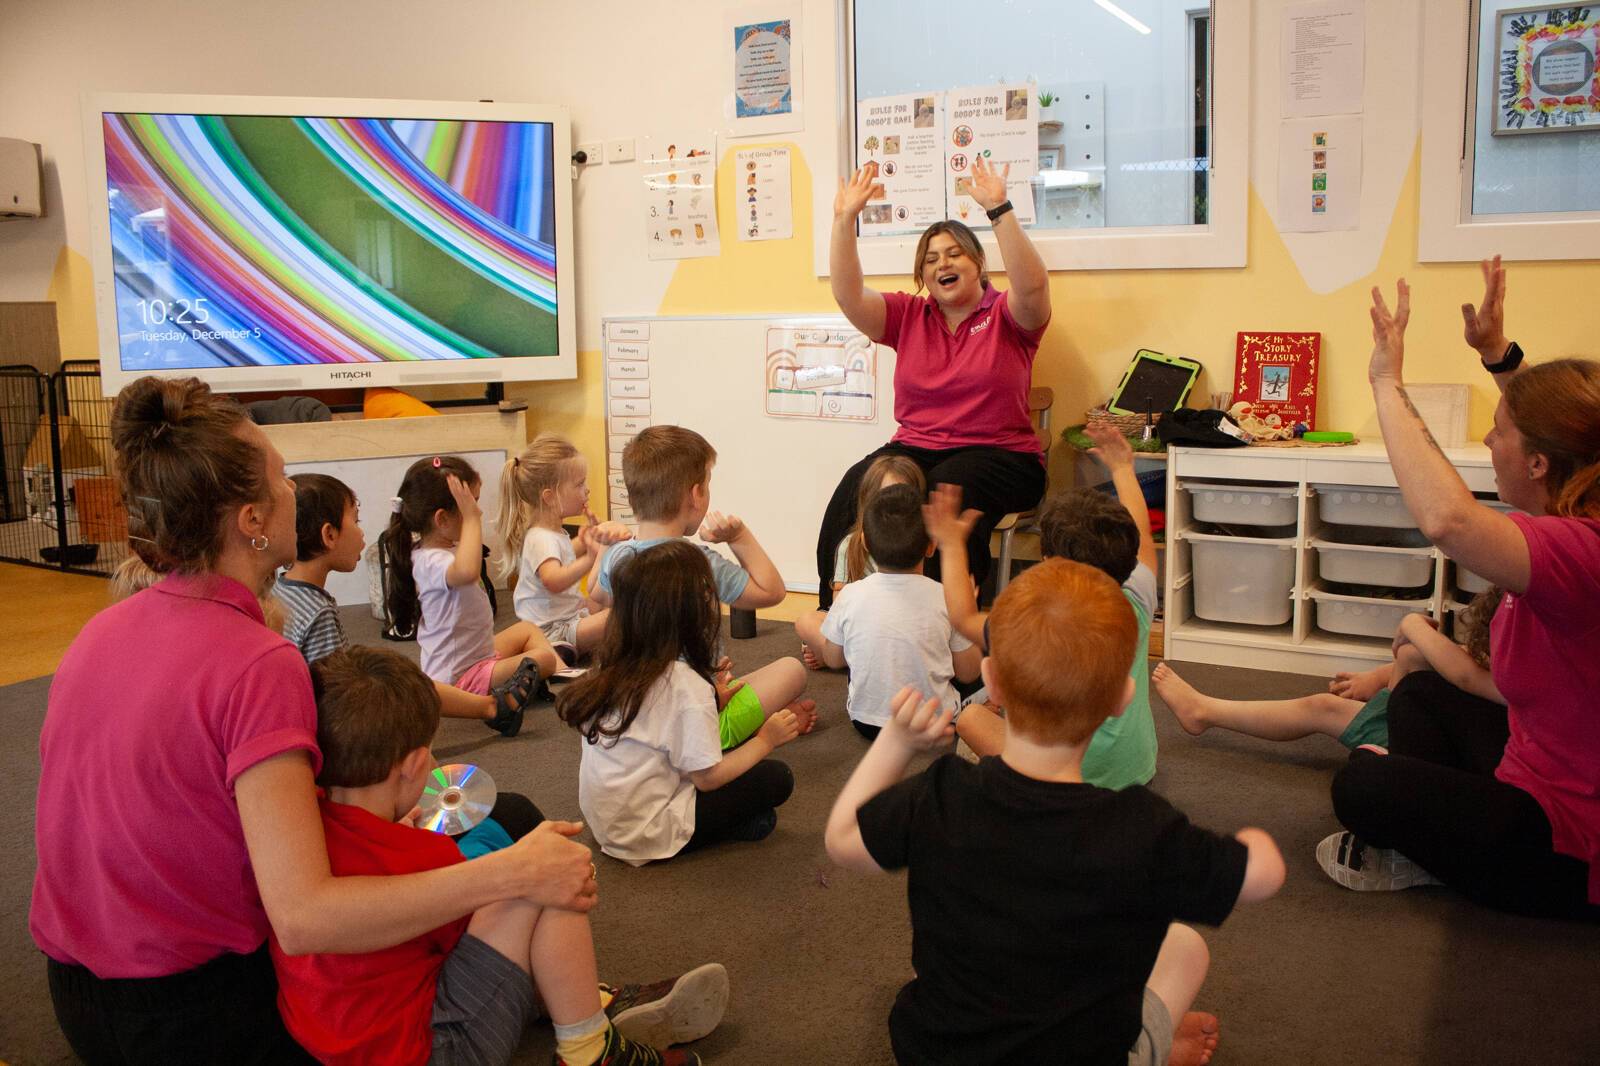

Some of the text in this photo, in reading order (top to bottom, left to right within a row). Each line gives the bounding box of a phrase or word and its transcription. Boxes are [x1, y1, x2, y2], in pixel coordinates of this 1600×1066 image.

[650, 206, 660, 218] 3.
[654, 231, 663, 242] 4.
[137, 298, 210, 325] 10:25
[141, 327, 261, 343] Tuesday, December 5
[330, 371, 372, 379] HITACHI
